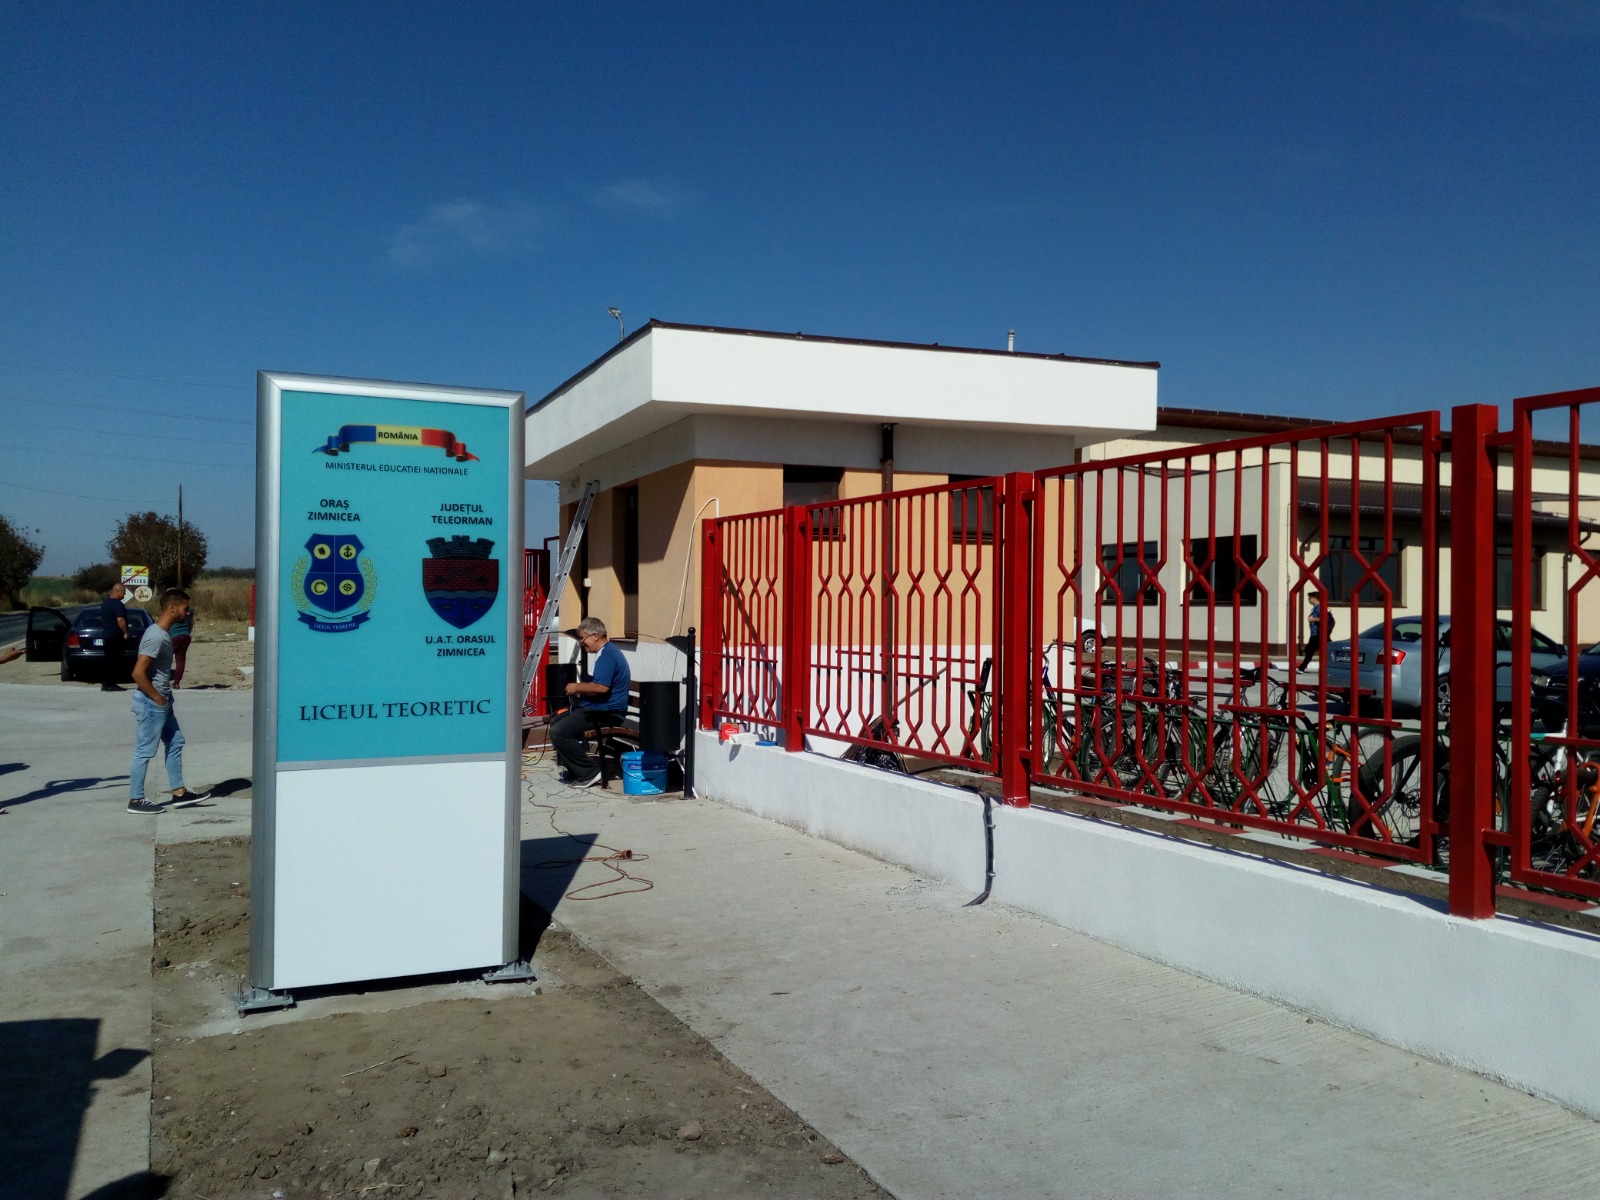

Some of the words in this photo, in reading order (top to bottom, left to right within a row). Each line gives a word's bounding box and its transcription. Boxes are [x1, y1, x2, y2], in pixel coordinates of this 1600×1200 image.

[378, 431, 418, 441] ROMÂNIA
[325, 461, 377, 472] MINISTERUL
[379, 464, 421, 474] EDUCAȚIEI
[423, 466, 468, 476] NAȚIONALE
[319, 498, 350, 510] ORAȘ
[440, 503, 484, 514] JUDEȚUL
[307, 511, 361, 522] ZIMNICEA
[431, 515, 493, 525] TELEORMAN
[425, 635, 454, 644] U.A.T.
[456, 634, 496, 644] ORASUL
[436, 648, 486, 657] ZIMNICEA
[299, 703, 378, 722] LICEUL
[382, 699, 491, 718] TEORETIC
